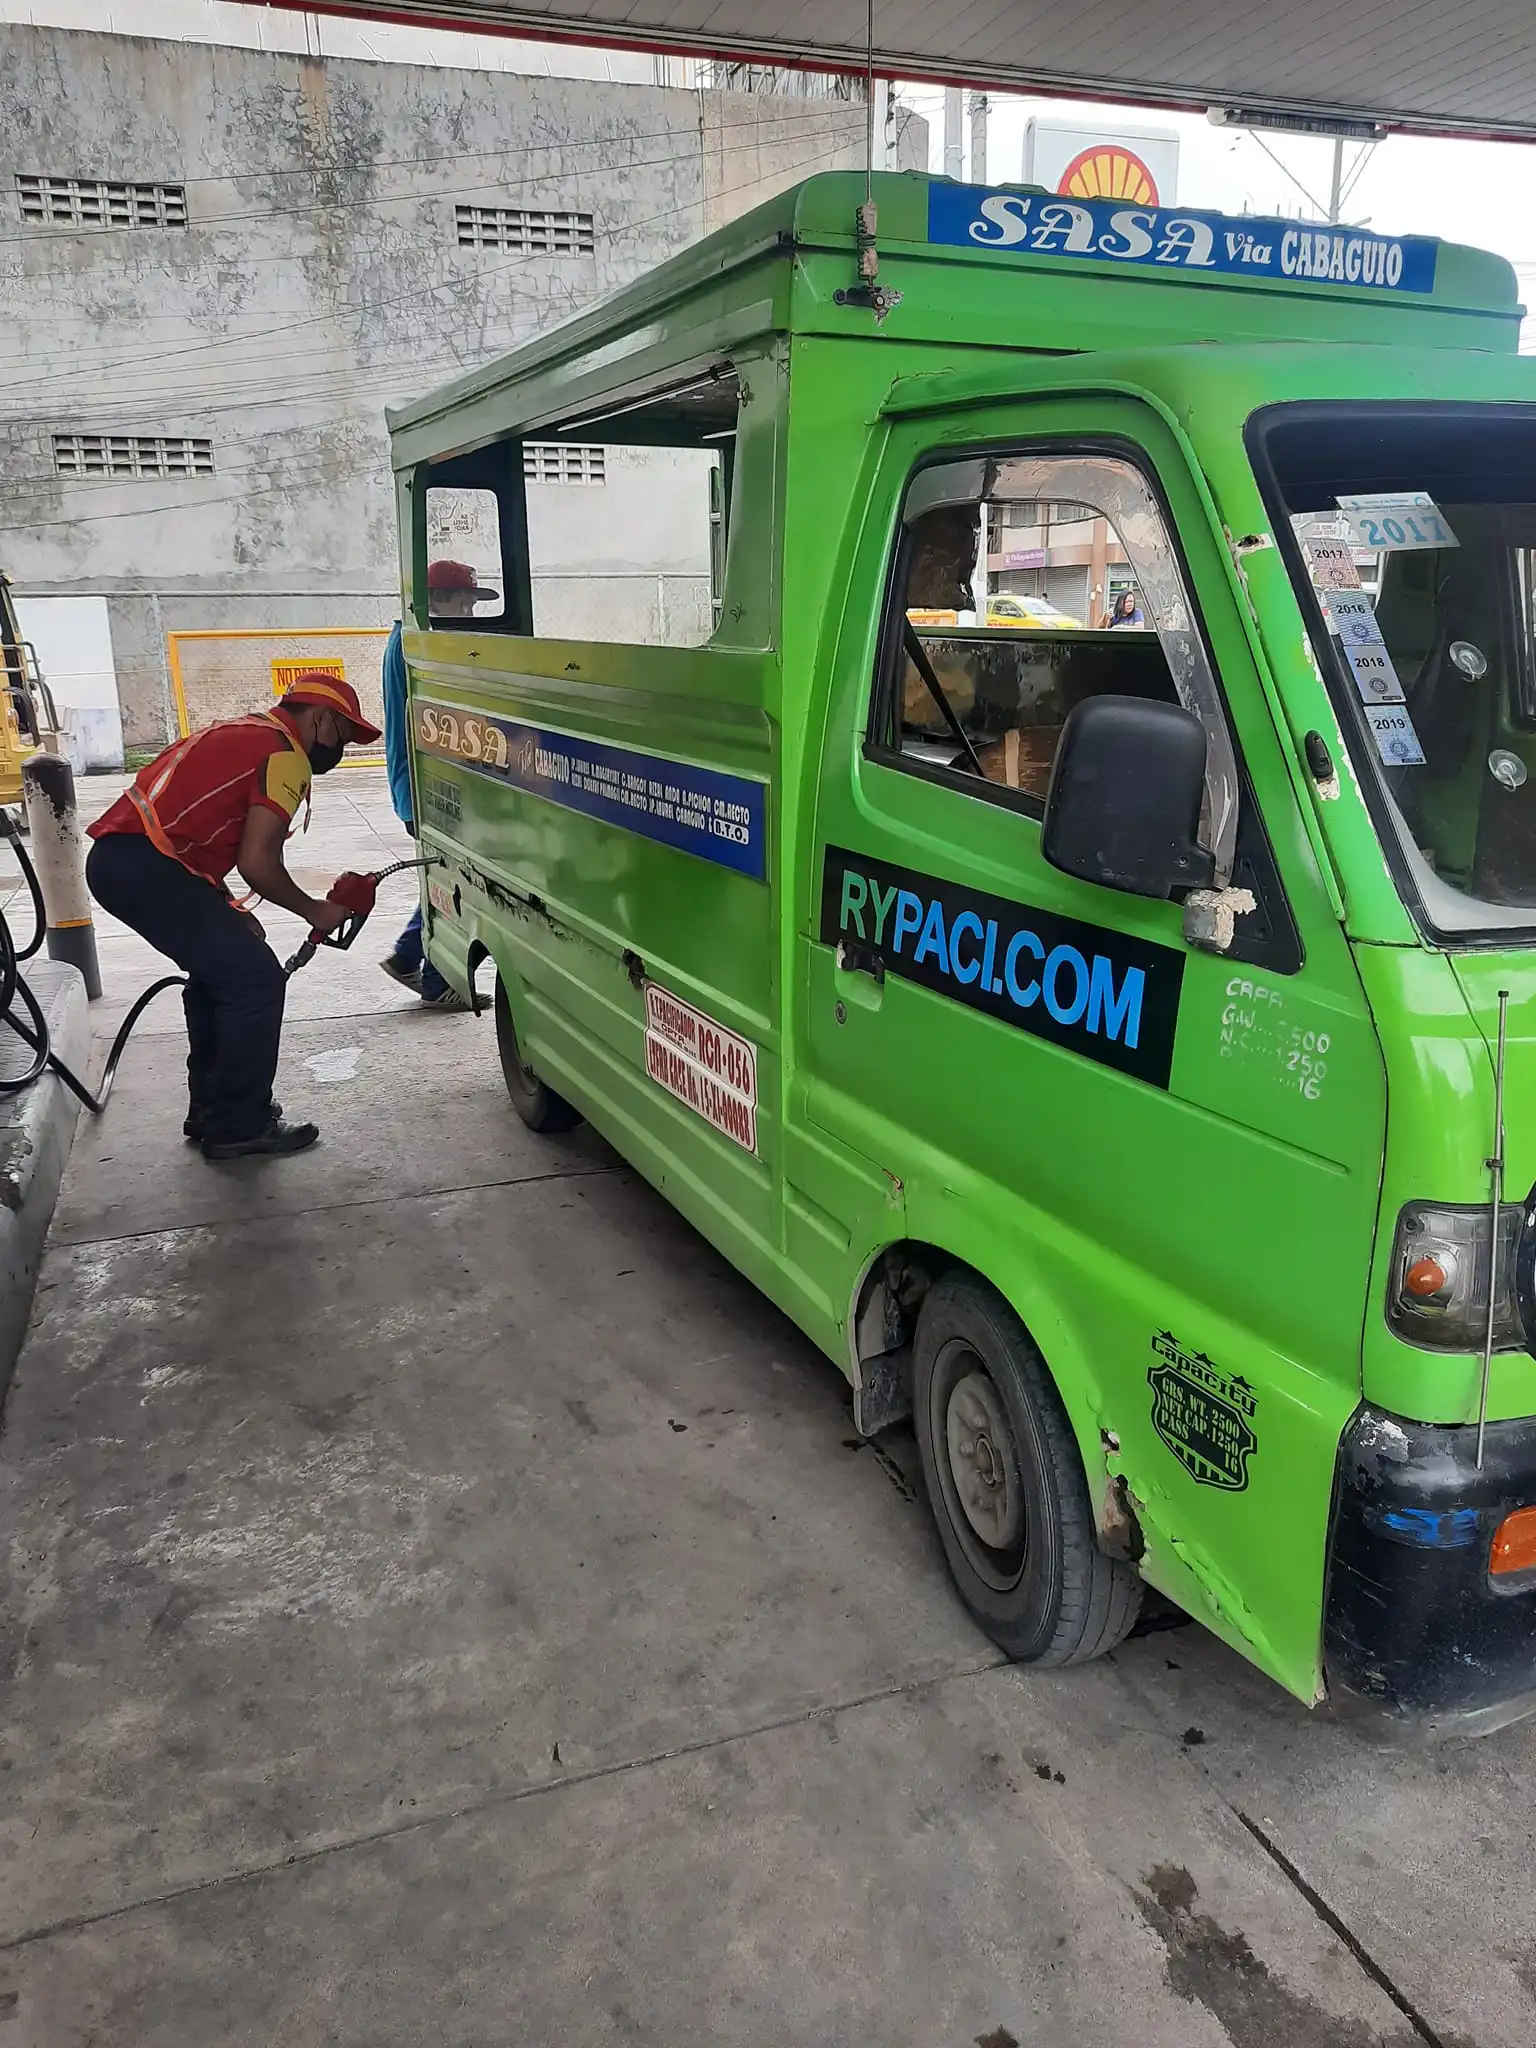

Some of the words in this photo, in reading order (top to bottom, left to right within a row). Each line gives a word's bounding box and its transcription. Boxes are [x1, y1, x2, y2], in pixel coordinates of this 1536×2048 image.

[968, 196, 1216, 266] SASA
[1224, 231, 1271, 265] Via
[1280, 230, 1402, 287] CABAGUIO
[1314, 549, 1343, 559] 2017
[1360, 517, 1447, 546] 2017
[1337, 604, 1366, 615] 2016
[277, 668, 291, 686] NO
[1354, 657, 1385, 668] 2018
[421, 707, 509, 768] SASA
[535, 747, 570, 784] CABAGUIO
[1374, 718, 1405, 729] 2019
[840, 869, 1146, 1049] RYPACI.COM
[669, 1055, 688, 1099] CASE
[1151, 1335, 1259, 1417] Capacity
[1162, 1377, 1187, 1405] GRS.
[1190, 1394, 1208, 1420] WT.
[1212, 1409, 1240, 1439] 2500
[1162, 1393, 1184, 1418] NET
[1212, 1428, 1239, 1457] 1250
[1161, 1409, 1189, 1440] PASS
[1225, 1453, 1238, 1474] 16
